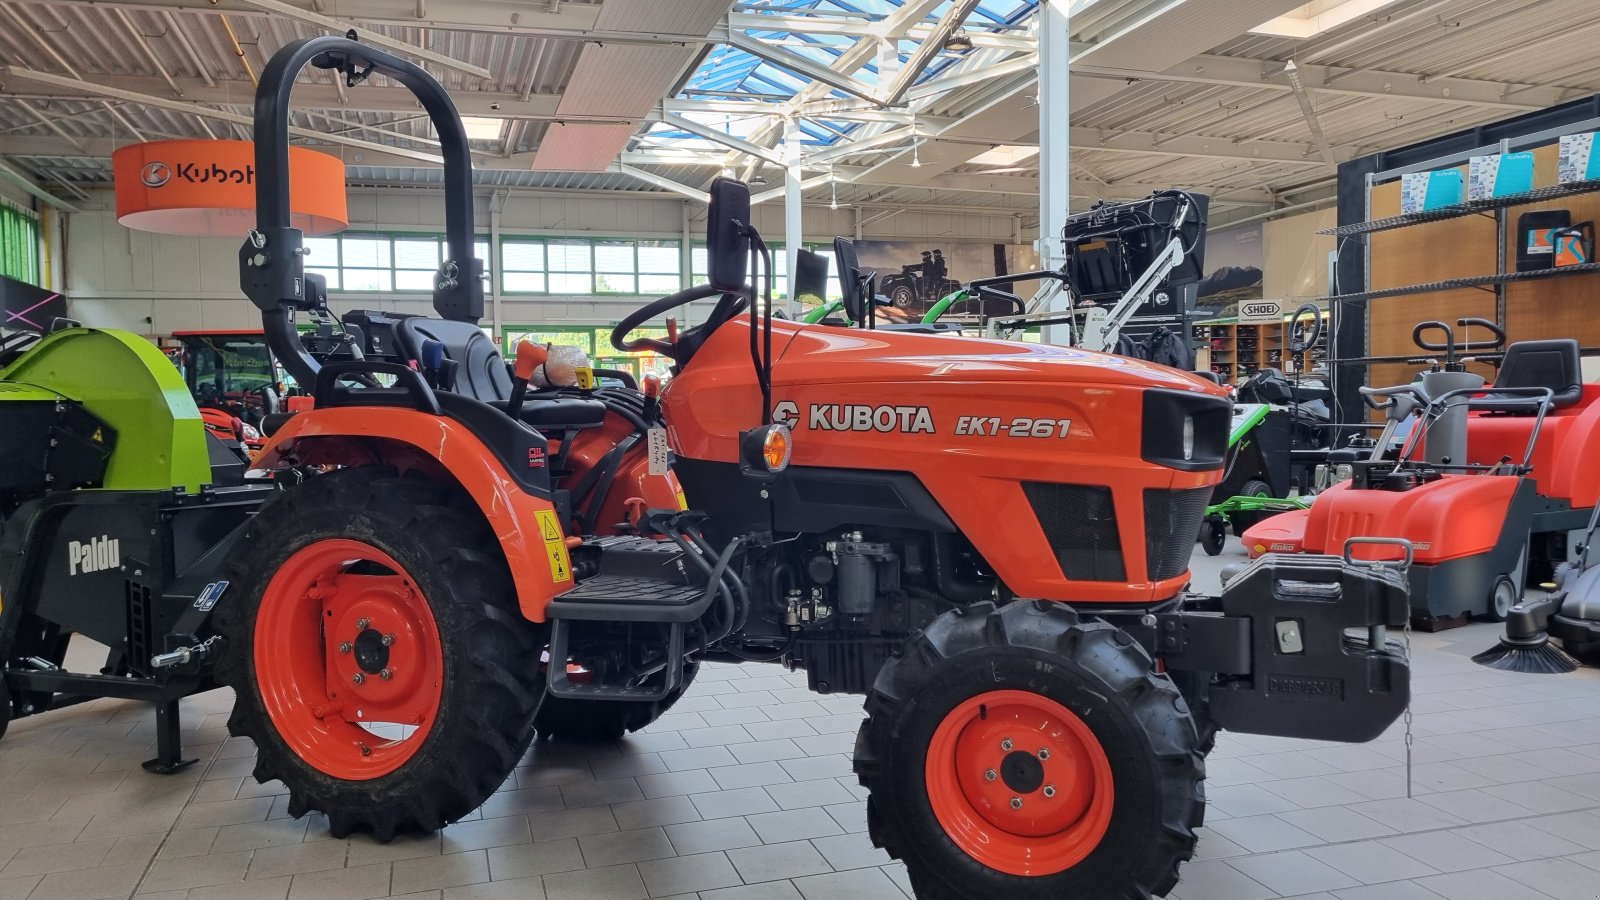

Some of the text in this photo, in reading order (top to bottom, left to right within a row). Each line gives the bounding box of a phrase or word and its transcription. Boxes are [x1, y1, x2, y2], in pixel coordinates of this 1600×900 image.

[176, 163, 255, 184] Kubot
[1247, 305, 1275, 314] SHOEI
[809, 404, 936, 434] KUBOTA
[954, 416, 1072, 439] EK1-261
[68, 534, 120, 576] Paldu
